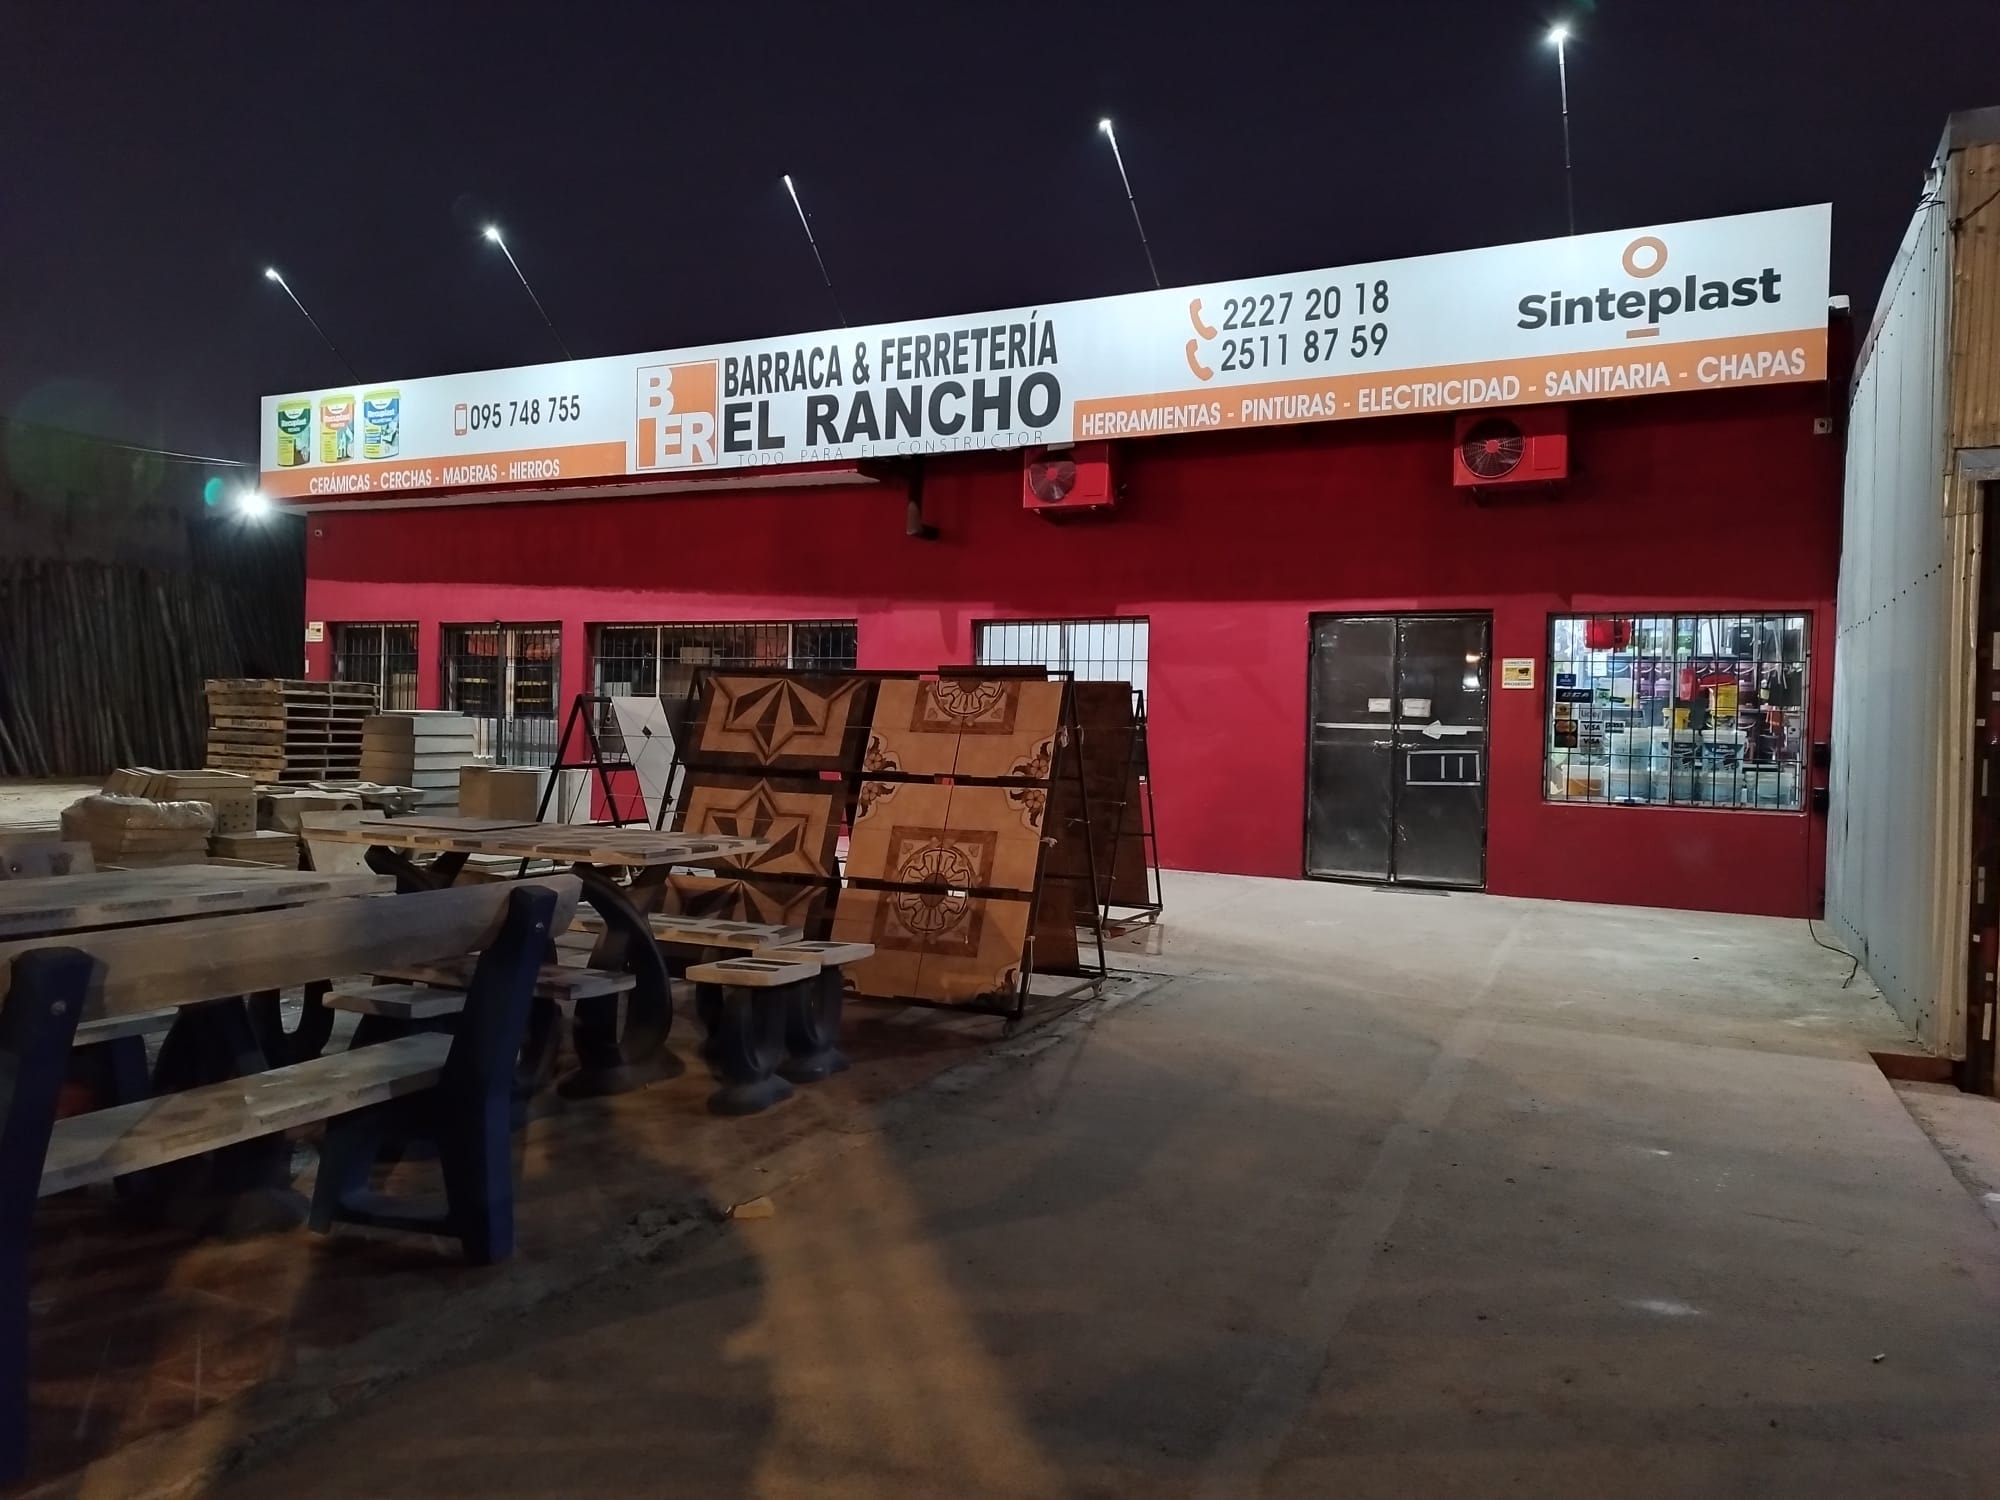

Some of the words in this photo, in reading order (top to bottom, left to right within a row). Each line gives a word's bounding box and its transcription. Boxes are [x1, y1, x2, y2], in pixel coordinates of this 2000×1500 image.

[1223, 292, 1292, 331] 2227
[1304, 286, 1341, 321] 20
[1355, 280, 1389, 315] 18
[1517, 267, 1782, 330] Sinteplast
[725, 345, 842, 398] BARRACA
[853, 342, 871, 385] &
[881, 311, 1058, 382] FERRETERÍA
[1221, 334, 1287, 371] 2511
[1303, 328, 1338, 363] 87
[1351, 322, 1388, 358] 59
[471, 404, 502, 431] 095
[510, 399, 540, 427] 748
[549, 395, 580, 422] 755
[724, 400, 785, 453] EL
[806, 371, 1061, 446] RANCHO
[1082, 402, 1221, 436] HERRAMIENTAS
[1241, 391, 1336, 422] PINTURAS
[1358, 376, 1521, 413] ELECTRICIDAD
[1545, 361, 1670, 398] SANITARIA
[1697, 347, 1806, 383] CHAPAS
[737, 451, 785, 467] TODO
[800, 447, 844, 461] PARA
[896, 431, 1044, 455] CONSTRUCTOR
[309, 472, 370, 494] CERÁMICAS
[380, 469, 432, 490] CERCHAS
[443, 464, 498, 485] MADERAS
[509, 459, 560, 480] HIERROS
